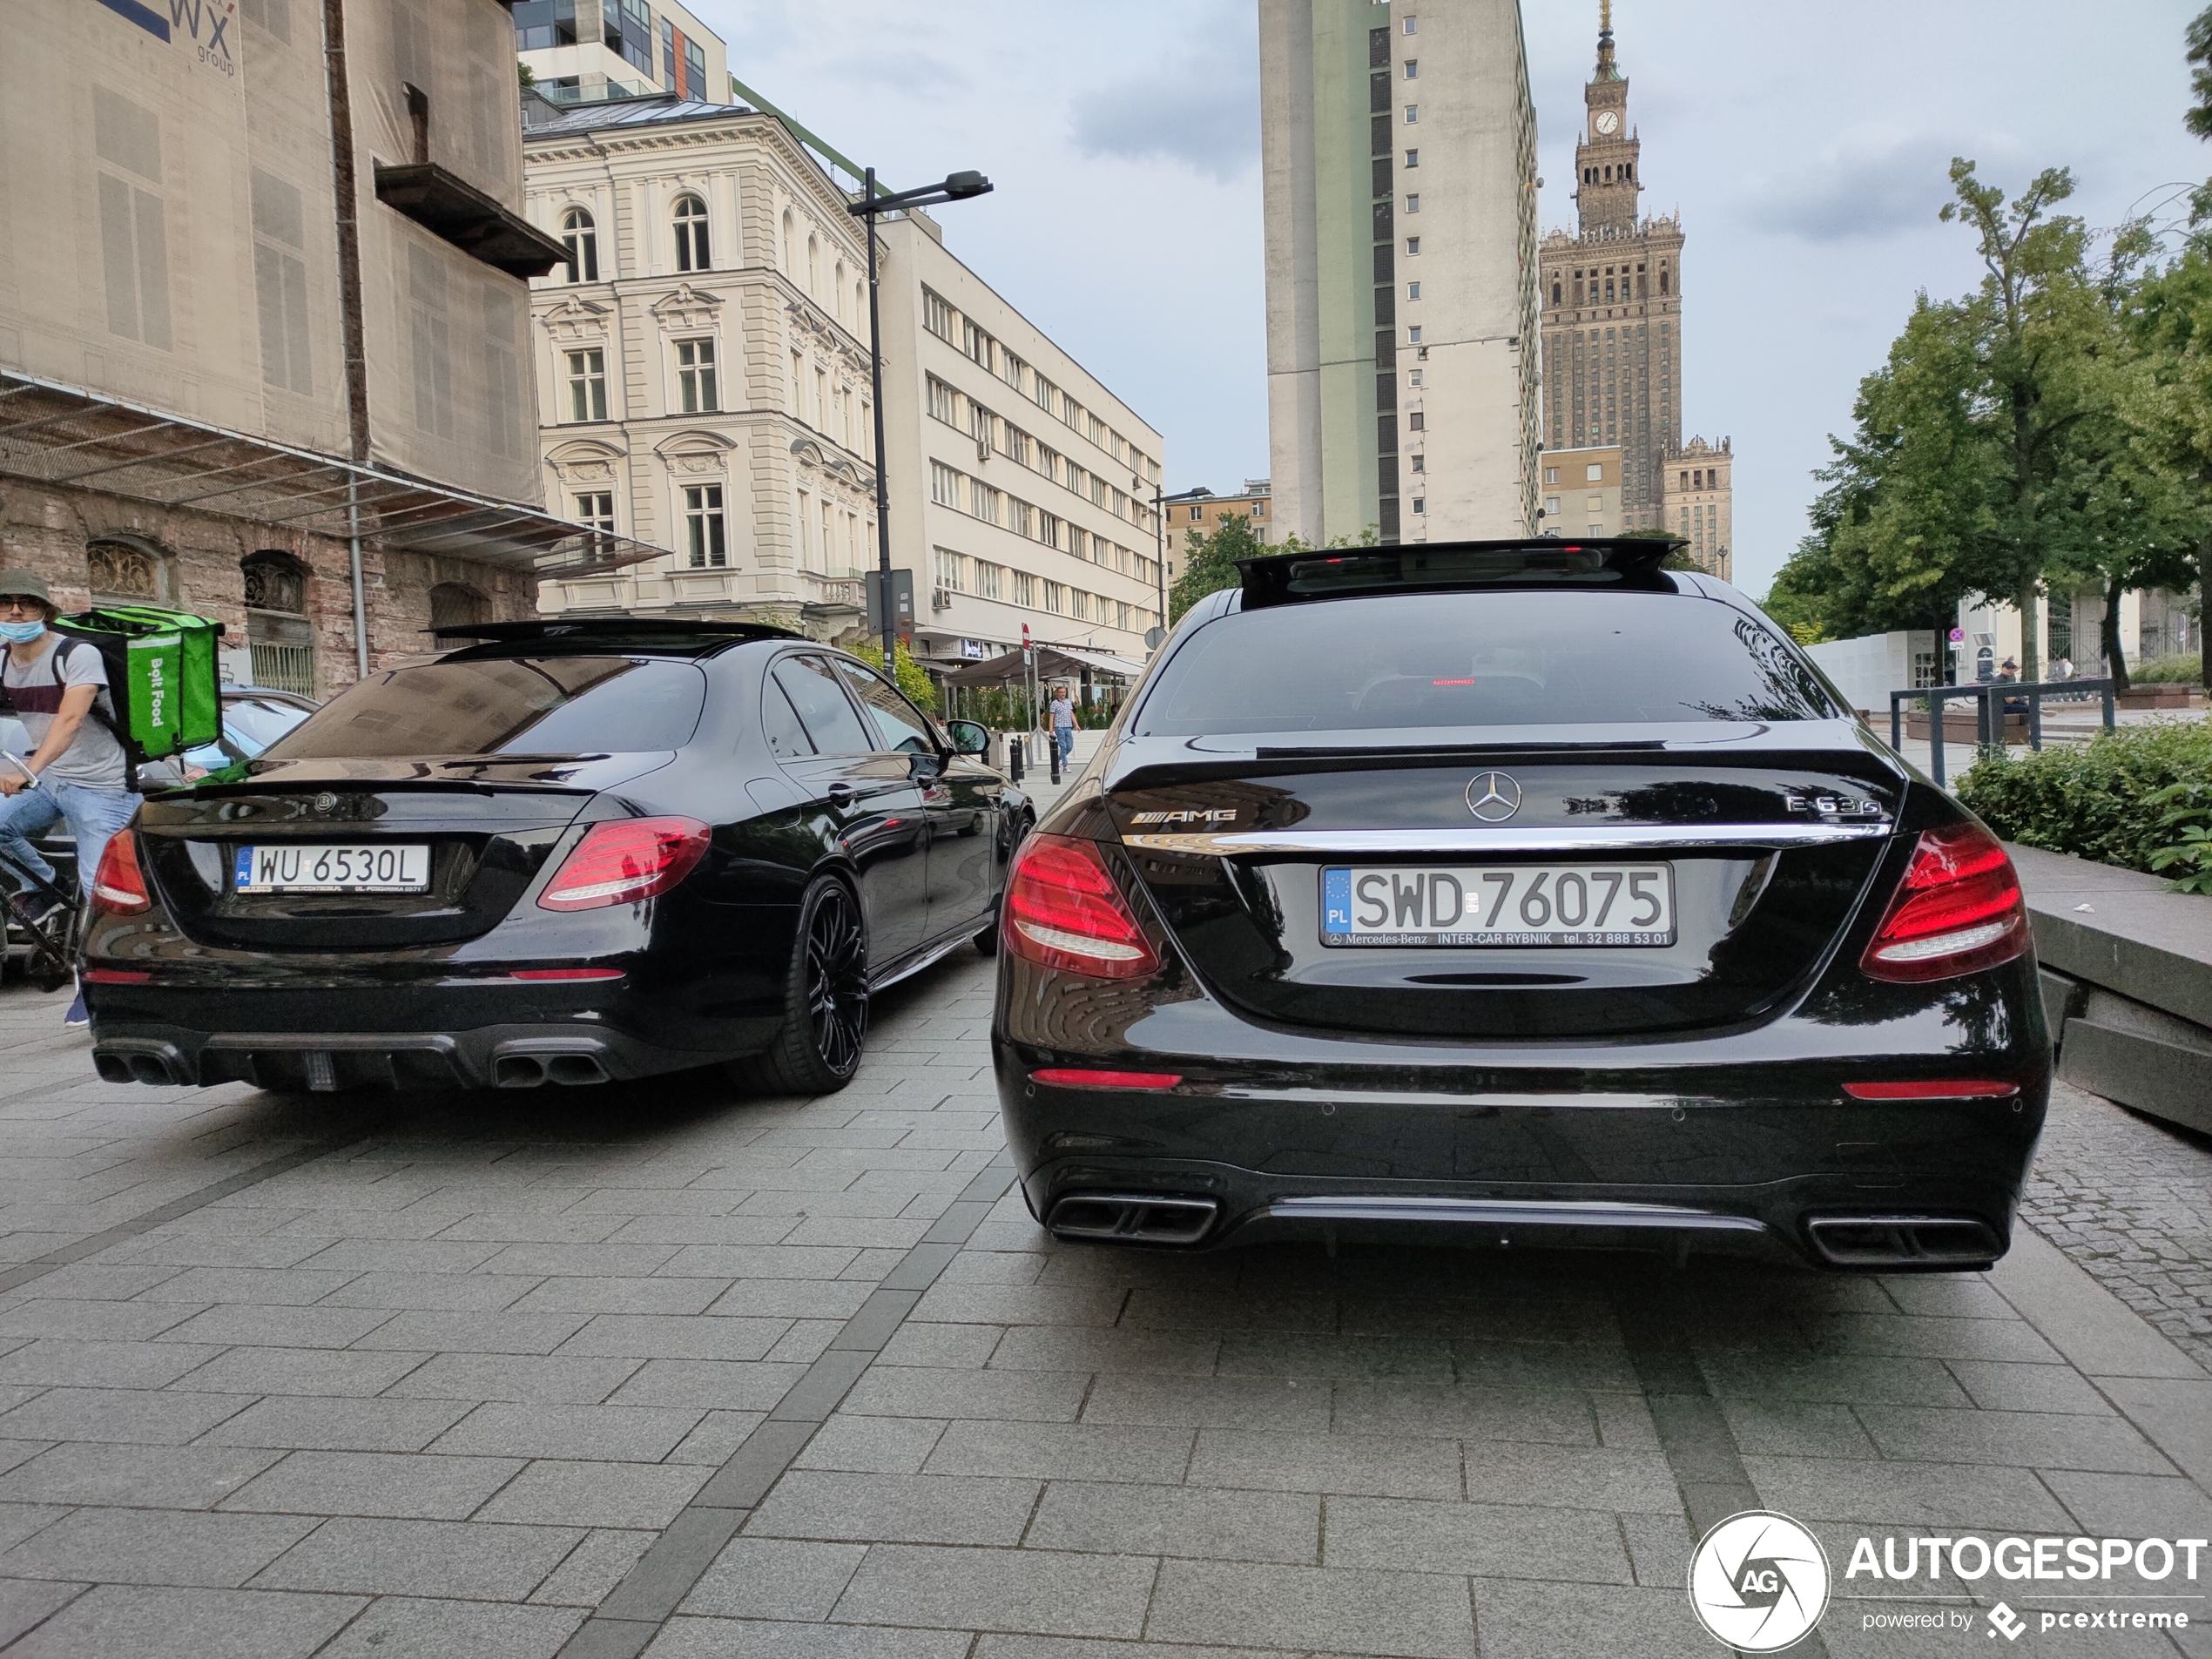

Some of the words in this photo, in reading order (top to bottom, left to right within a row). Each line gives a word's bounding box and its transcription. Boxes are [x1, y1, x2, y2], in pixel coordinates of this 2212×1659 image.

[198, 44, 234, 78] group
[148, 658, 164, 688] Bolt
[152, 690, 165, 727] Food
[1786, 796, 1808, 812] E
[1163, 809, 1237, 823] AMG
[238, 872, 249, 880] PL
[260, 849, 300, 882] WU
[314, 849, 416, 882] 6530L
[1356, 873, 1463, 927] SWD
[1482, 872, 1662, 927] 76075
[1328, 910, 1348, 923] PL
[1345, 934, 1427, 944] Mercedes-Benz
[1439, 933, 1502, 944] INTER-CAR
[1506, 933, 1552, 944] RYBNIK
[1563, 933, 1582, 944] tel.
[1587, 933, 1602, 944] 32
[1606, 933, 1629, 944] 888
[1634, 933, 1650, 944] 53
[1654, 933, 1668, 944] 01
